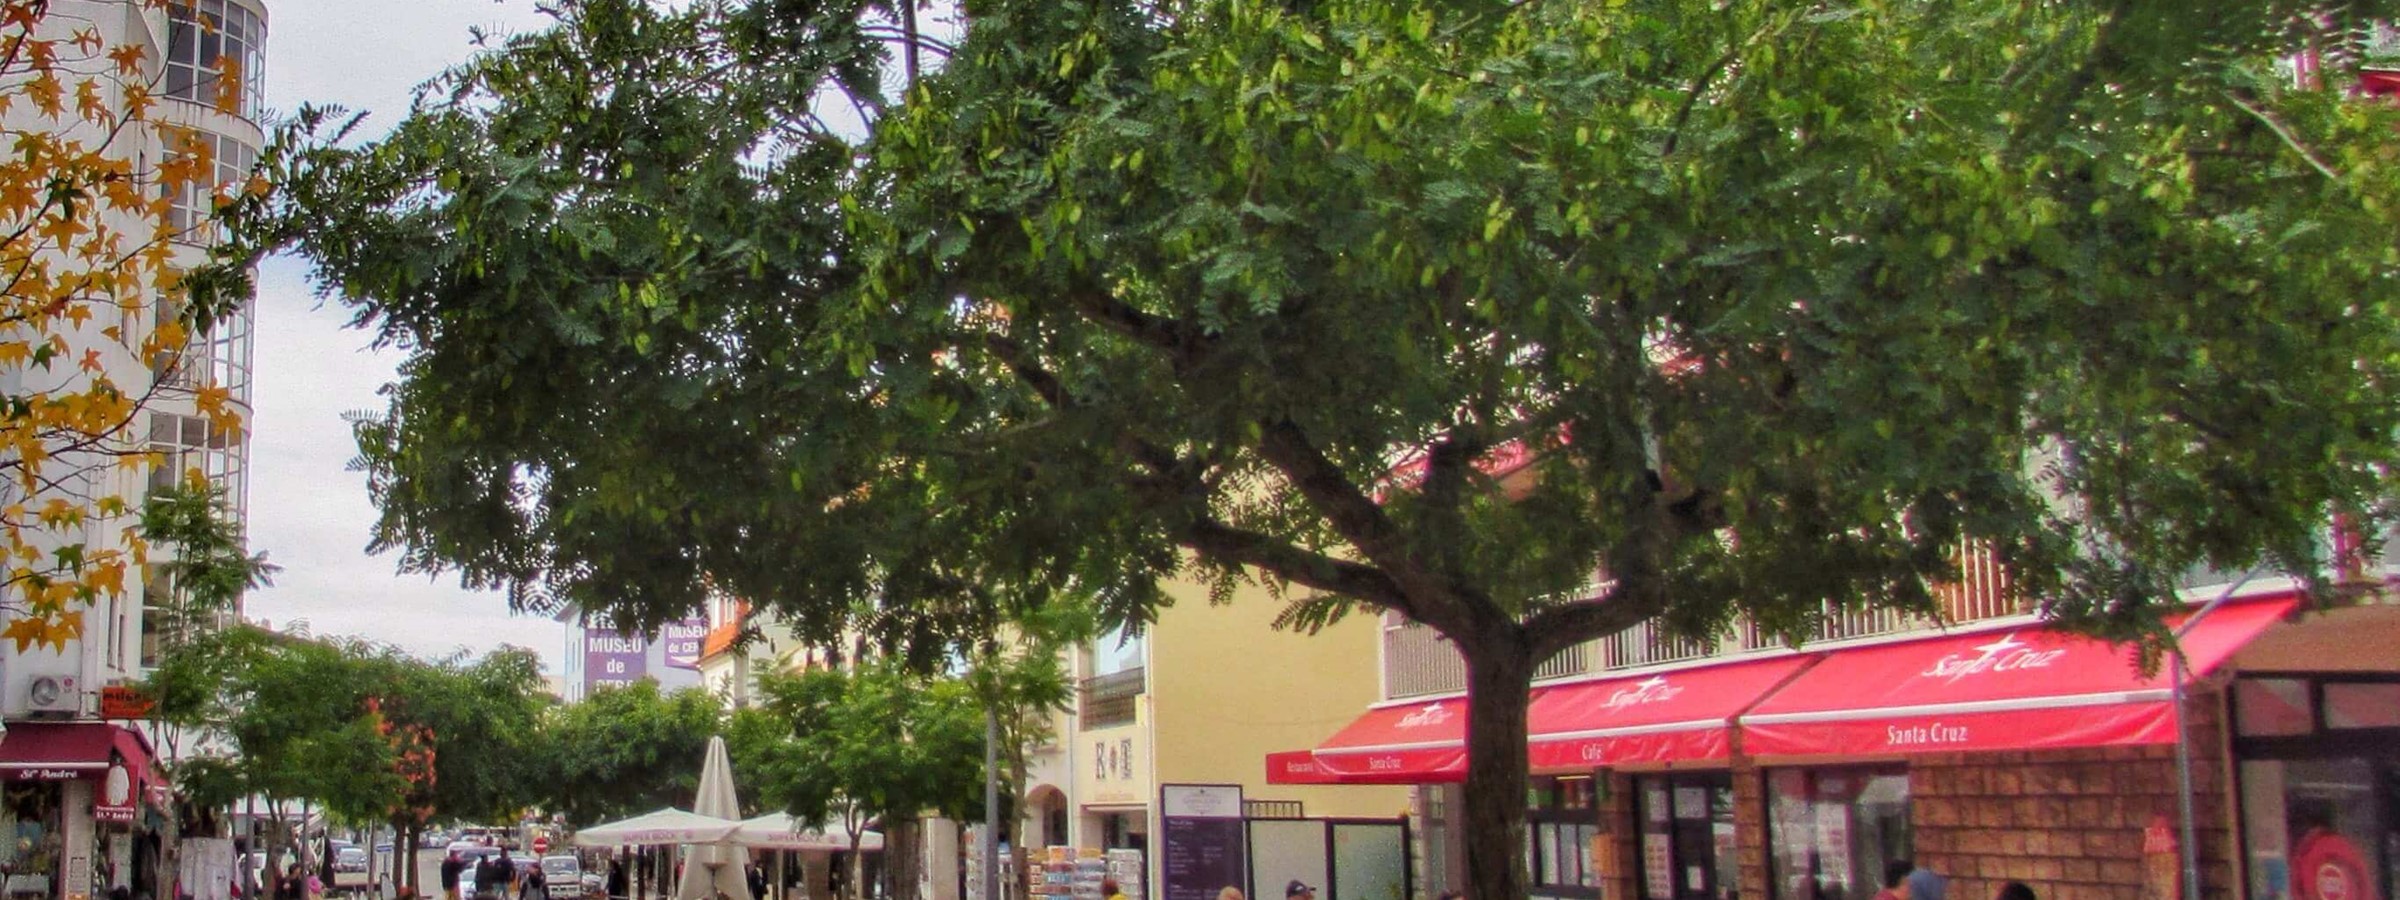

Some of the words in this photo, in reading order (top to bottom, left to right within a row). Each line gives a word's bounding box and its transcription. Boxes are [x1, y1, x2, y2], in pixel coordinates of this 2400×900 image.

[589, 637, 642, 653] MUSEU
[669, 642, 679, 654] de
[606, 658, 626, 674] de
[1921, 636, 1999, 686] Santa
[1993, 648, 2065, 672] Cruz
[1886, 725, 1927, 745] Santa
[1931, 723, 1968, 742] Cruz
[1369, 756, 1386, 770] Santa
[1386, 755, 1402, 769] Cruz
[40, 769, 78, 779] André
